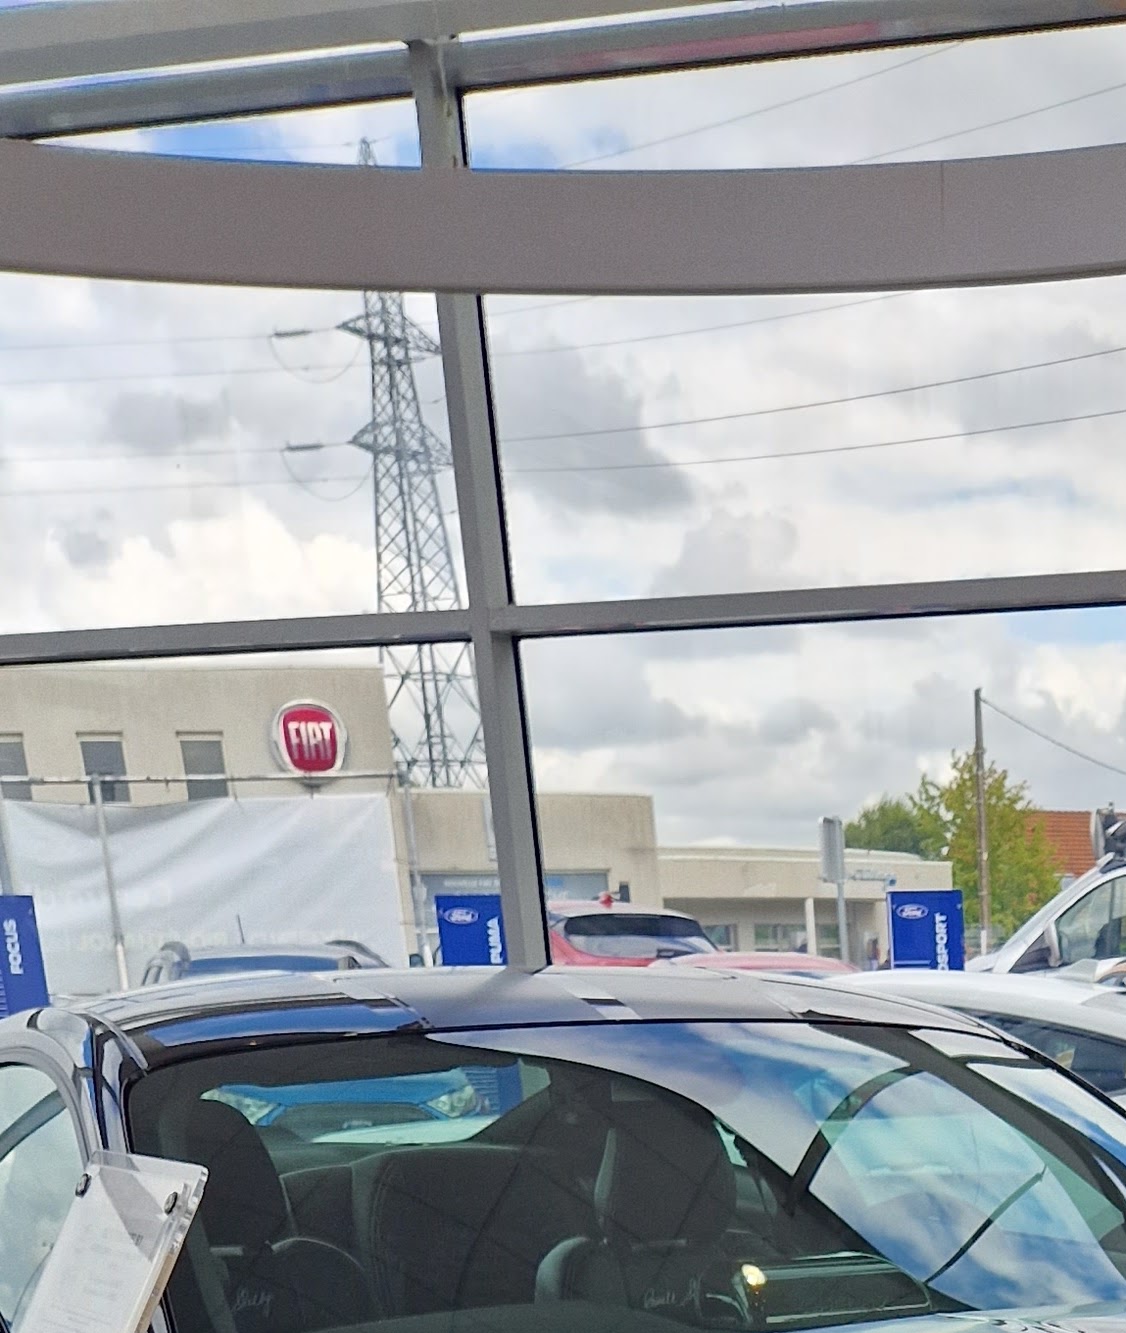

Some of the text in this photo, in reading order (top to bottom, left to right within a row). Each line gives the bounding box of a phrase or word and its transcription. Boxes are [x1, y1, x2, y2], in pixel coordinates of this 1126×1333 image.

[287, 721, 333, 761] FIAT
[448, 909, 475, 923] Ford
[899, 906, 925, 918] Ford
[3, 918, 24, 975] FOCUS
[487, 916, 504, 965] PUMA
